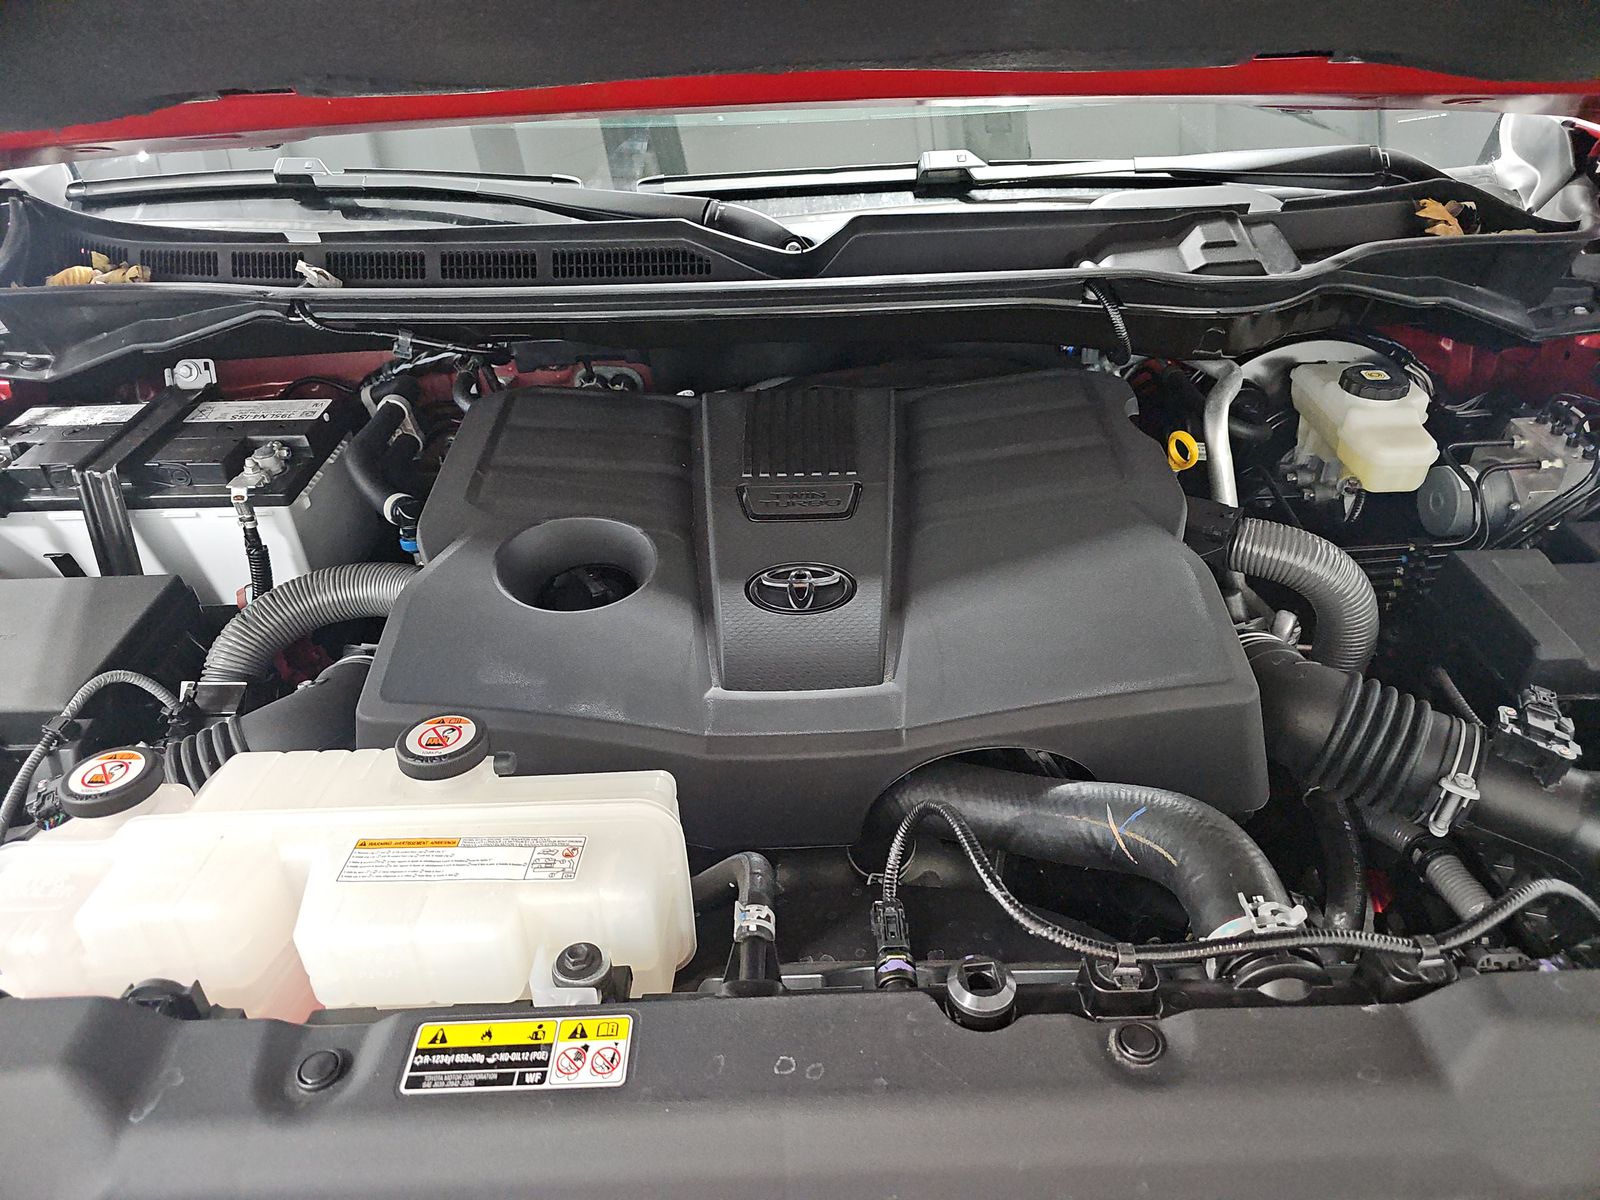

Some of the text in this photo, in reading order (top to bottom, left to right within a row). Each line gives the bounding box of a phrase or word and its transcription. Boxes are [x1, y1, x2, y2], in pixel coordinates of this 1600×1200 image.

[769, 490, 827, 500] TWIN
[759, 498, 841, 508] TURBO
[529, 1050, 549, 1062] (POE)
[463, 1072, 498, 1081] CORPORATION
[525, 1072, 542, 1084] WF
